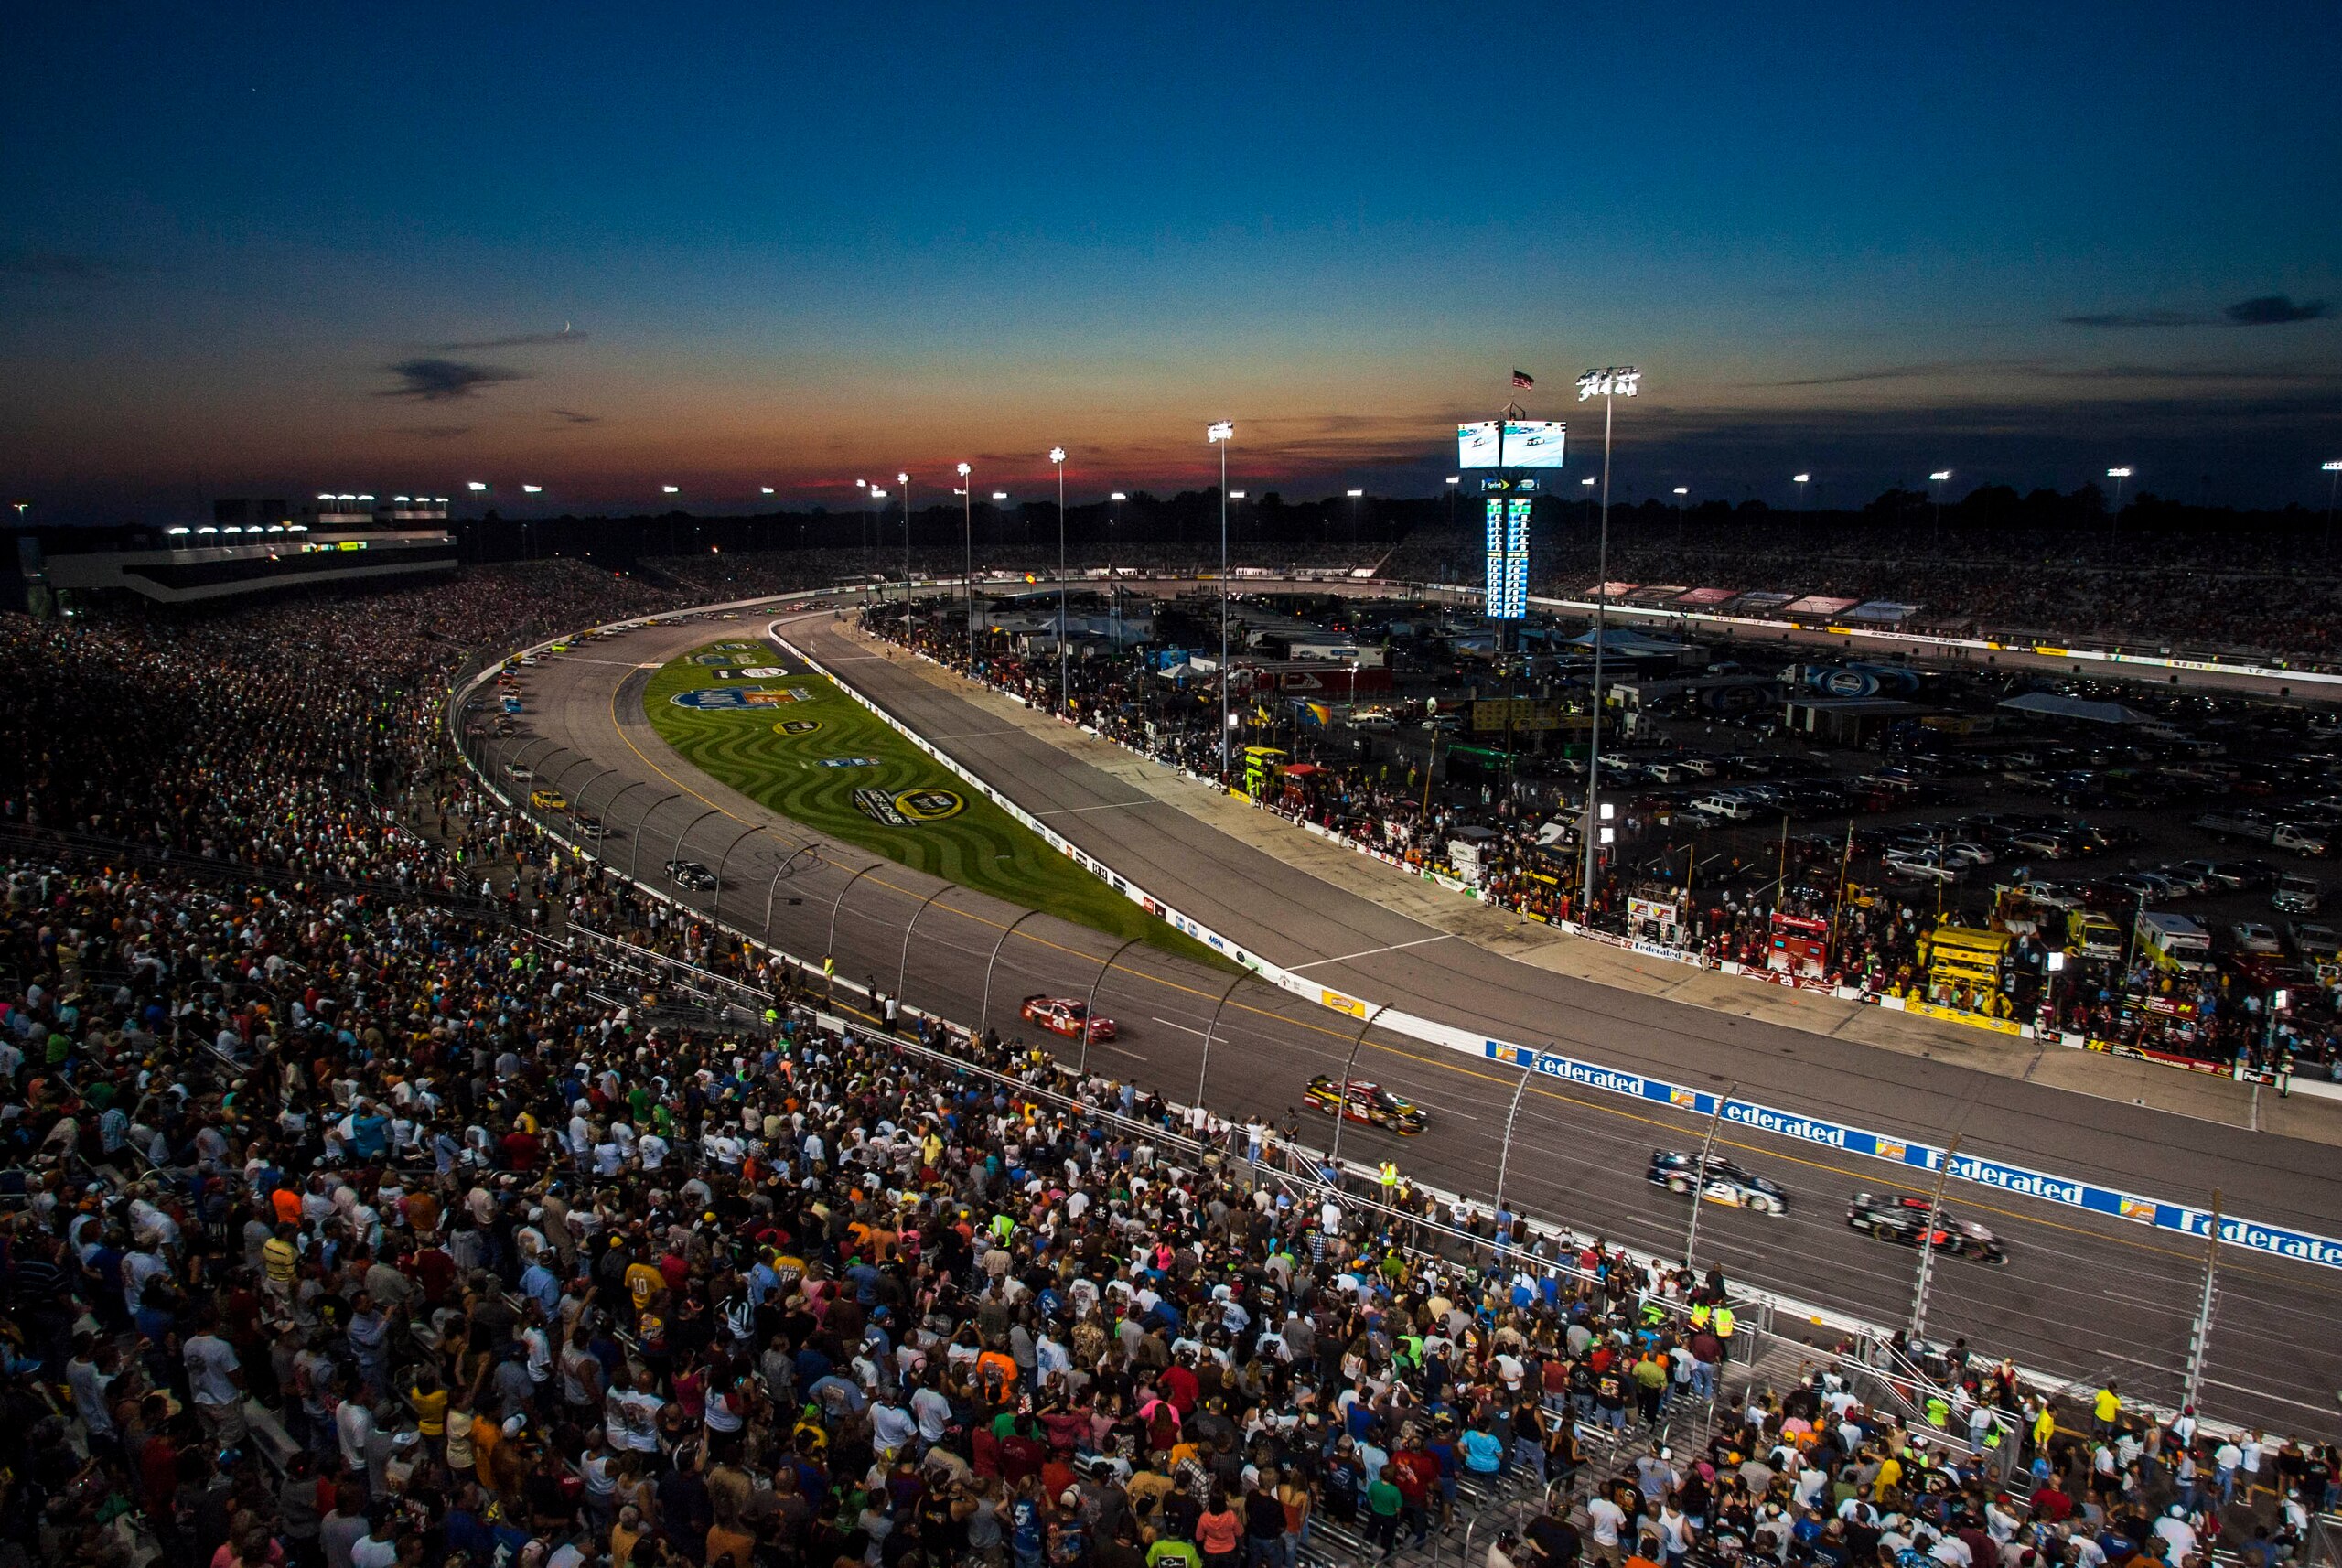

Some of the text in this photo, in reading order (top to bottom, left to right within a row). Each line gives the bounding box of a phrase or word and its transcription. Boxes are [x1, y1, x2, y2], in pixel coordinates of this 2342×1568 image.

[1208, 935, 1224, 950] MRN
[1622, 940, 1634, 950] 32
[1635, 942, 1681, 960] Federated
[1779, 975, 1794, 987] 29
[2177, 1004, 2192, 1013] 24
[2087, 1039, 2105, 1052] 24
[2244, 1071, 2274, 1085] FedEx
[1349, 1102, 1369, 1119] 15
[1926, 1150, 2083, 1206] Federated
[633, 1277, 647, 1294] 10
